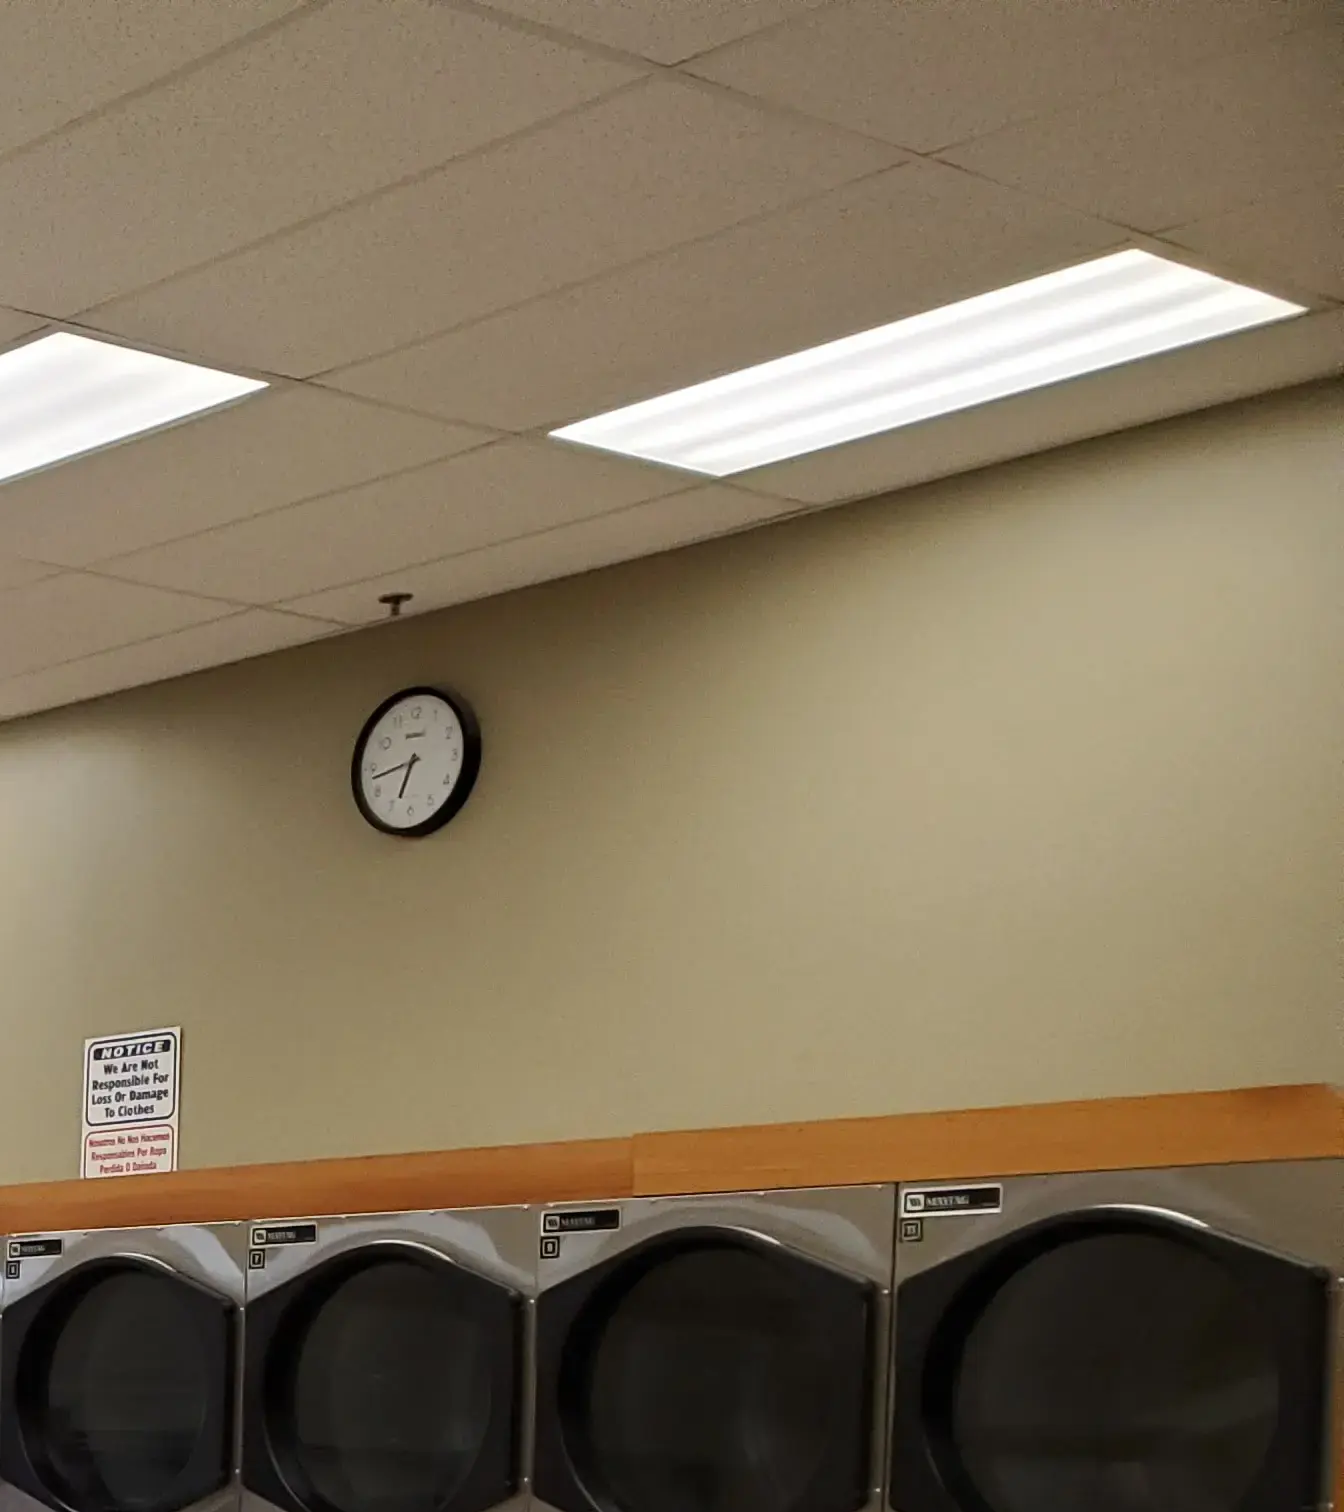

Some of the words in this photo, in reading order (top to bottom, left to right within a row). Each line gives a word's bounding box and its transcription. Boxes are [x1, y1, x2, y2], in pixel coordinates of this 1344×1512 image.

[101, 1041, 165, 1060] NOTICE
[104, 1064, 119, 1075] We
[121, 1062, 138, 1073] Are
[141, 1059, 159, 1070] Not
[92, 1076, 150, 1092] Responsible
[153, 1073, 170, 1084] For
[92, 1094, 112, 1105] Loss
[115, 1092, 127, 1102] Or
[129, 1088, 169, 1101] Damage
[104, 1107, 115, 1118] To
[118, 1104, 155, 1117] Clothes
